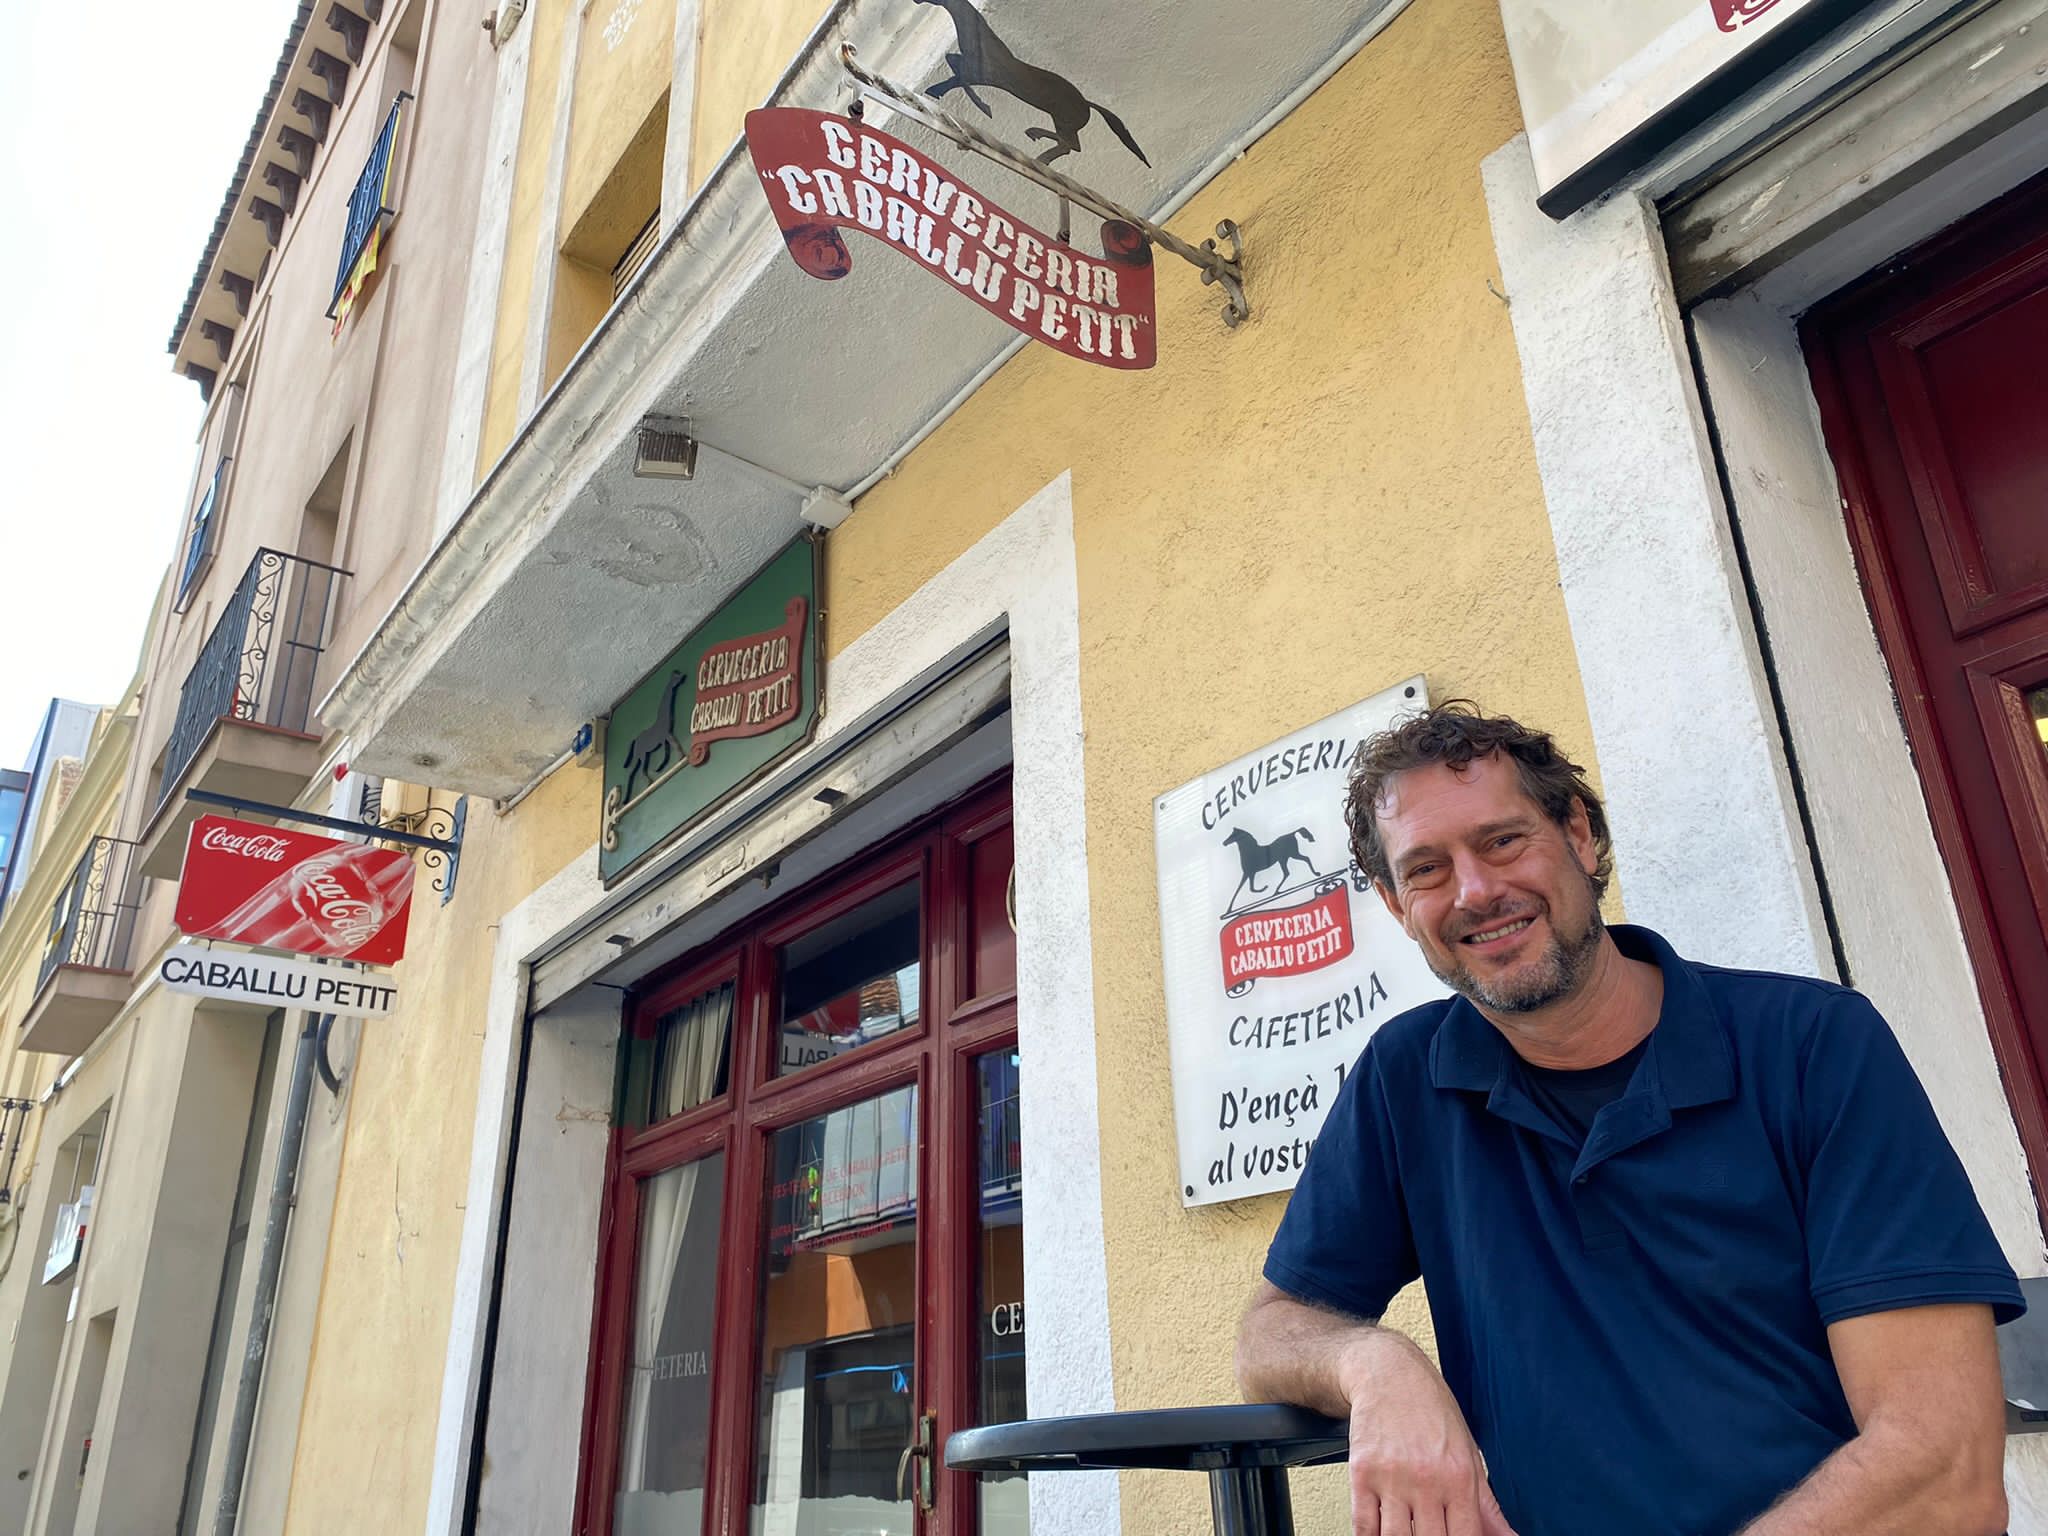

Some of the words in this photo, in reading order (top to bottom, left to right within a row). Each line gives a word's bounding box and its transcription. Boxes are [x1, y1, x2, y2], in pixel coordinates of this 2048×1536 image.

[820, 120, 1120, 308] CERVECERIA
[699, 636, 789, 691] CERVECERIA
[690, 692, 743, 734] CABALLU
[746, 673, 794, 724] PETIT
[1230, 944, 1294, 977] CABALLU
[1296, 926, 1343, 965] PETIT
[1235, 905, 1334, 947] CERVECERIA
[161, 957, 306, 999] CABALLU
[315, 978, 397, 1011] PETIT
[1228, 970, 1389, 1049] CAFETERIA
[1219, 1074, 1319, 1131] D'ençà
[1208, 1141, 1235, 1186] al
